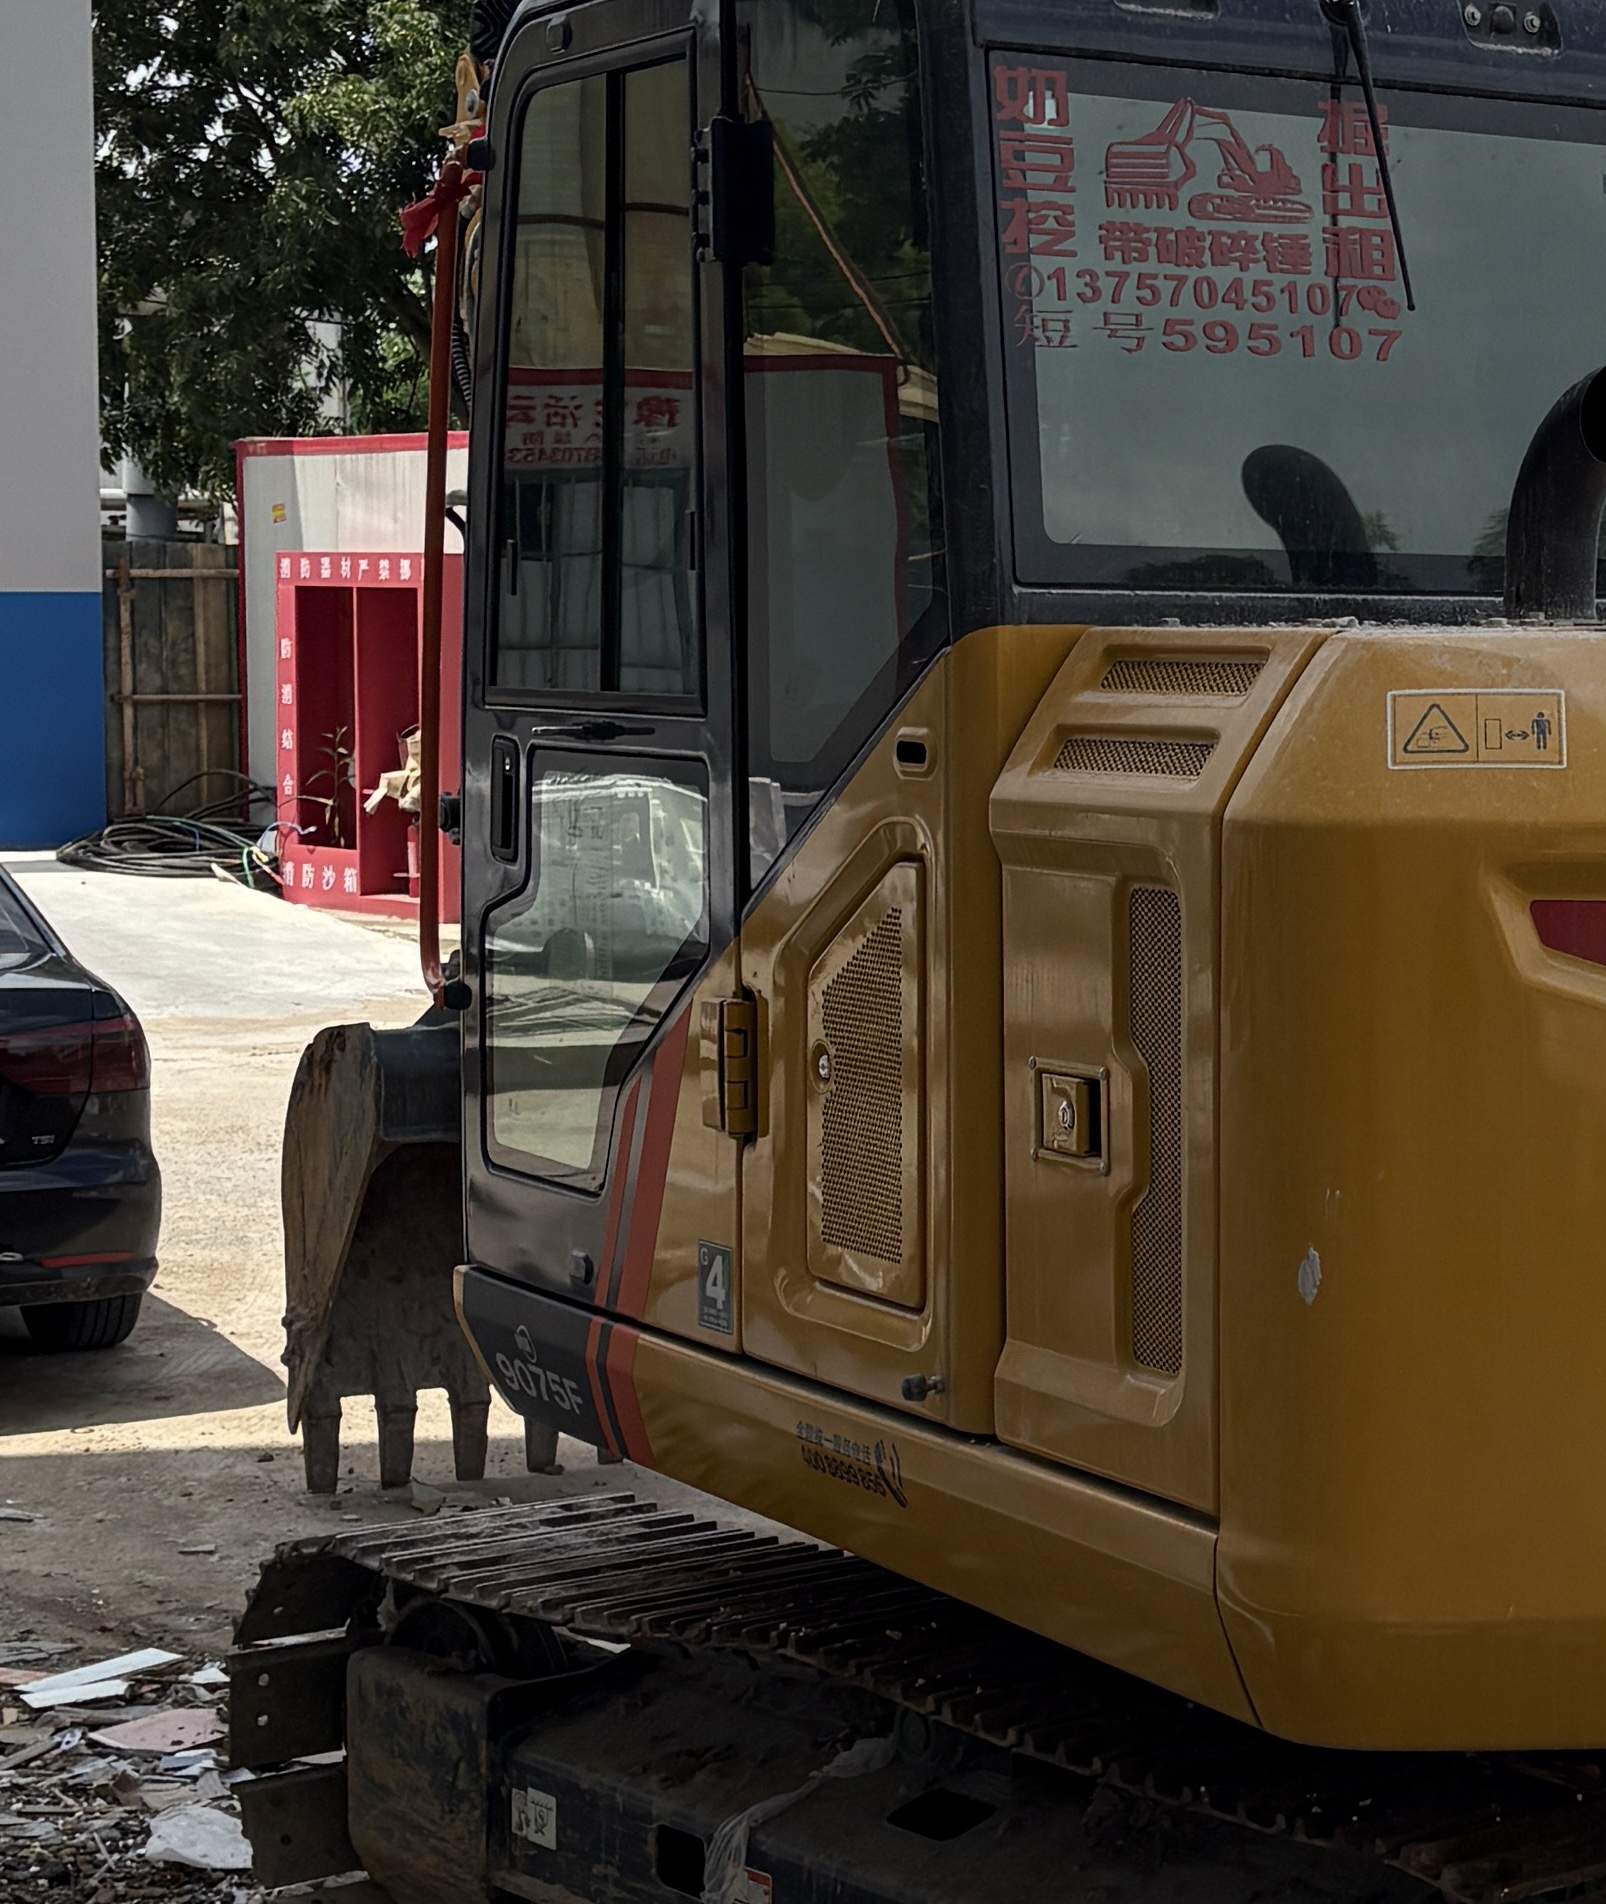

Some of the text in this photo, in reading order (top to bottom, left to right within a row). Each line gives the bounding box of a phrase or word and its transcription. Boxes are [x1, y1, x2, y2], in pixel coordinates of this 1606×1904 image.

[993, 66, 1077, 257] 奶豆挖
[1317, 99, 1396, 281] 掘出租
[1099, 221, 1313, 274] 带破碎锤
[1047, 267, 1360, 316] 13757045107
[280, 557, 424, 581] 消防器材严禁挪
[280, 637, 294, 796] 防消结合
[283, 861, 358, 893] 消防沙箱
[705, 1255, 726, 1310] 4
[496, 1352, 583, 1415] 9075F
